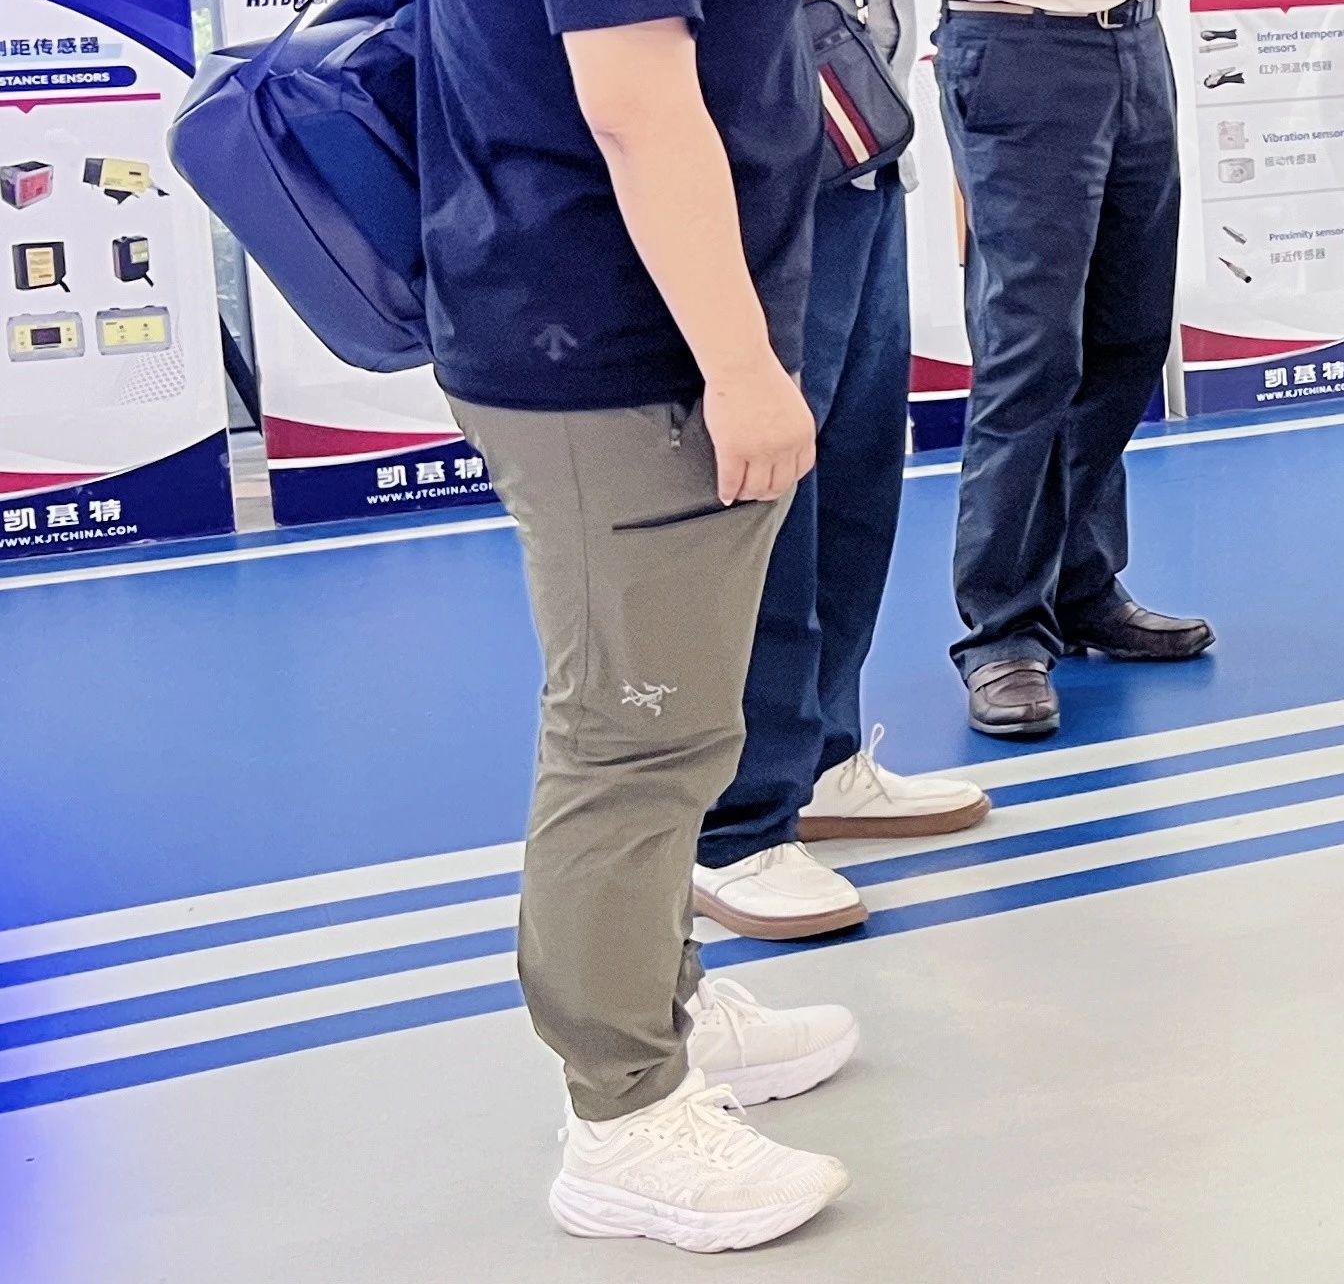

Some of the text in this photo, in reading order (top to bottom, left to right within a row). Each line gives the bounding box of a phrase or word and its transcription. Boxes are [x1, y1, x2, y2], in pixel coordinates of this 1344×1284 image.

[1257, 31, 1298, 42] Infrared
[1257, 45, 1297, 55] sensors
[51, 72, 111, 85] SENSORS
[1262, 132, 1310, 143] Vibration
[1269, 230, 1313, 242] Proximity
[1264, 361, 1344, 388] 凯基特
[376, 457, 483, 489] 凯基特
[366, 482, 493, 504] WWW.KJTCHINA.CO
[3, 499, 121, 532] 凯基特
